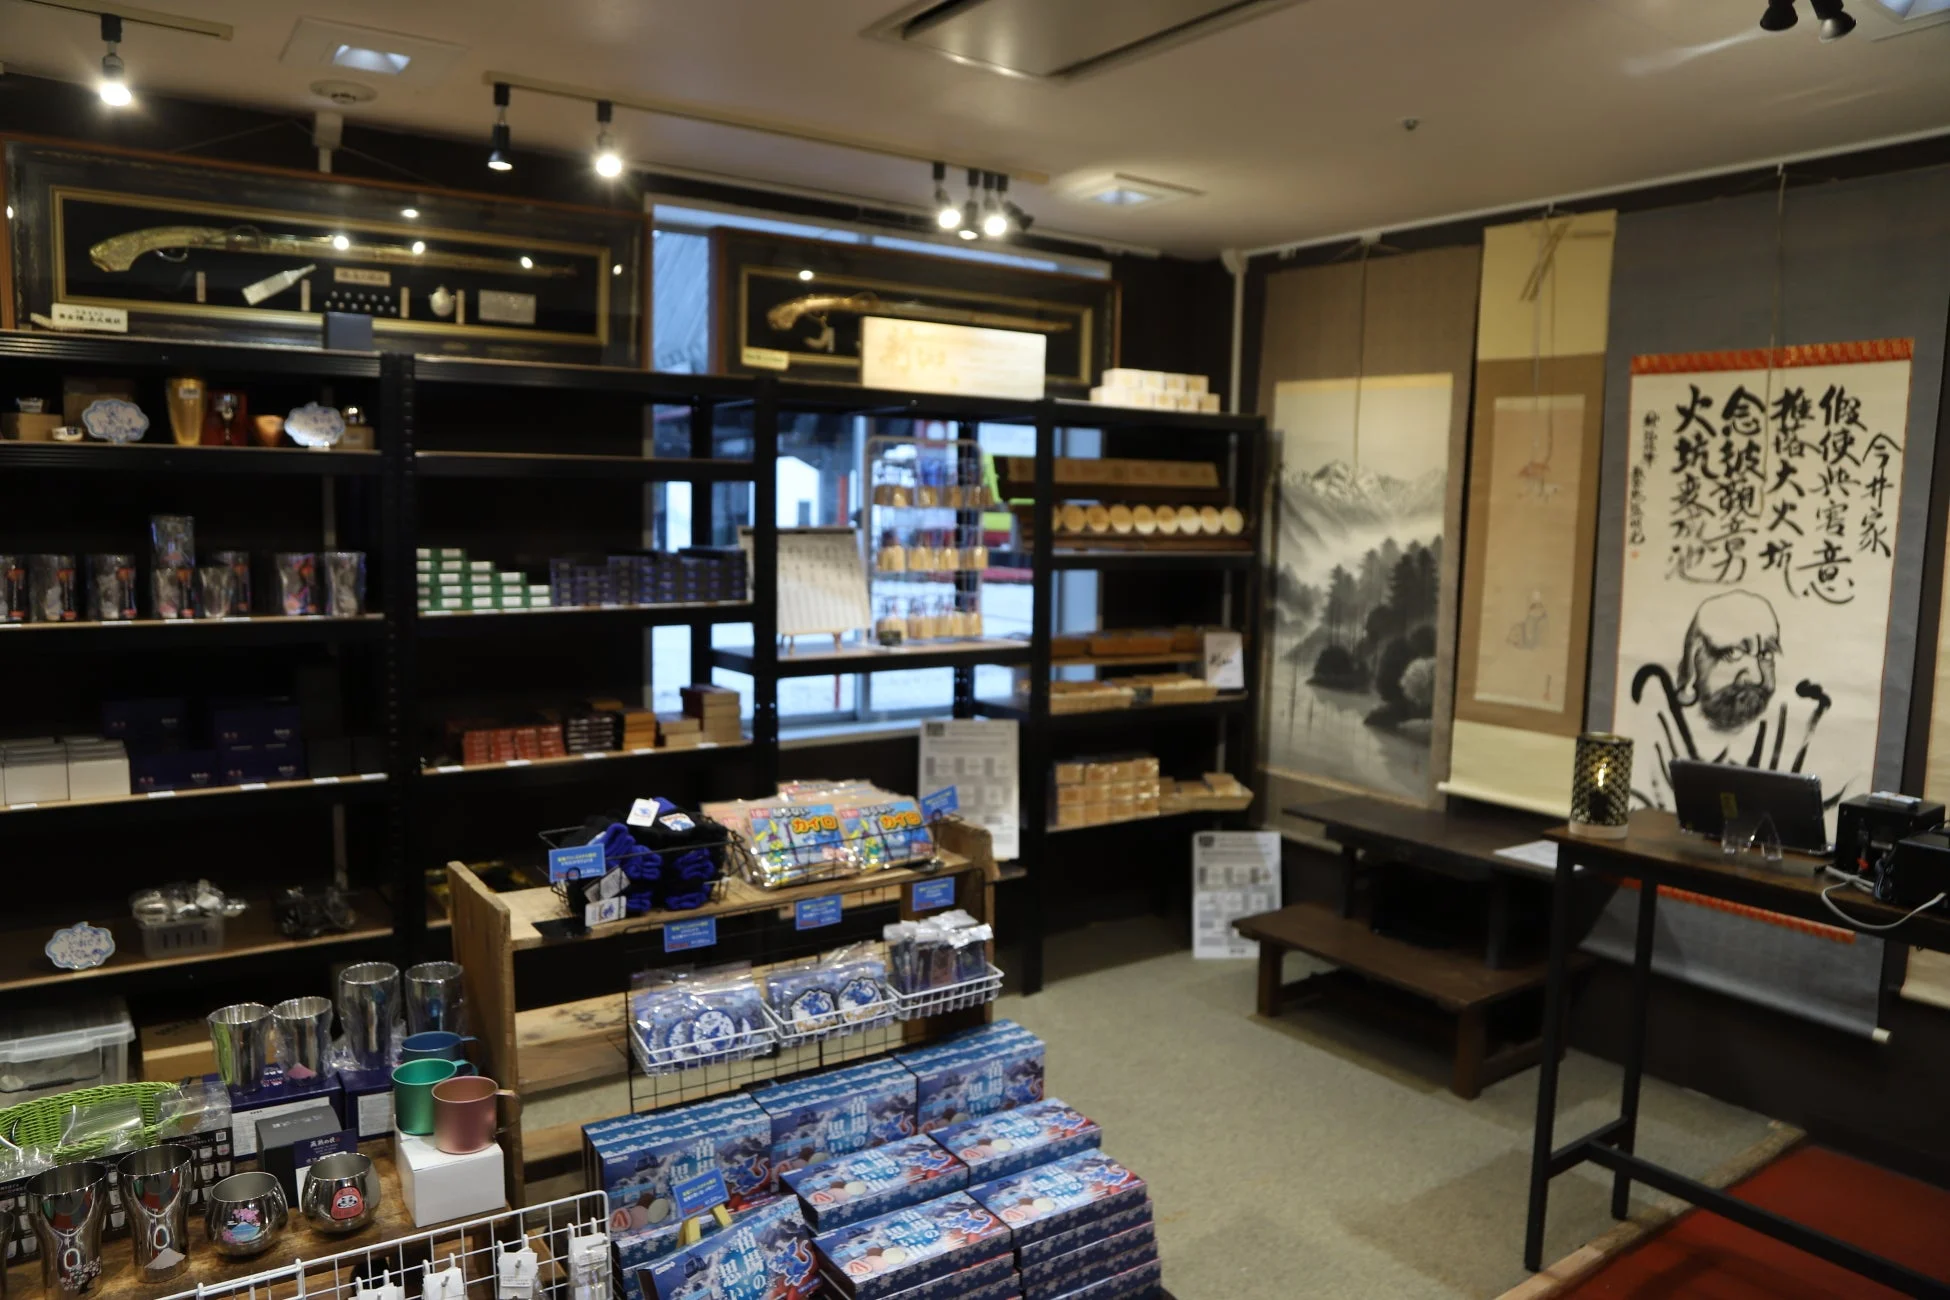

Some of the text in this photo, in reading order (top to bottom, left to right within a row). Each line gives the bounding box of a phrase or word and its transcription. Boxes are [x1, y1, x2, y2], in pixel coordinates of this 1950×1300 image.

[1860, 432, 1902, 558] 今井家
[792, 816, 839, 834] カイロ
[880, 811, 922, 830] カイロ
